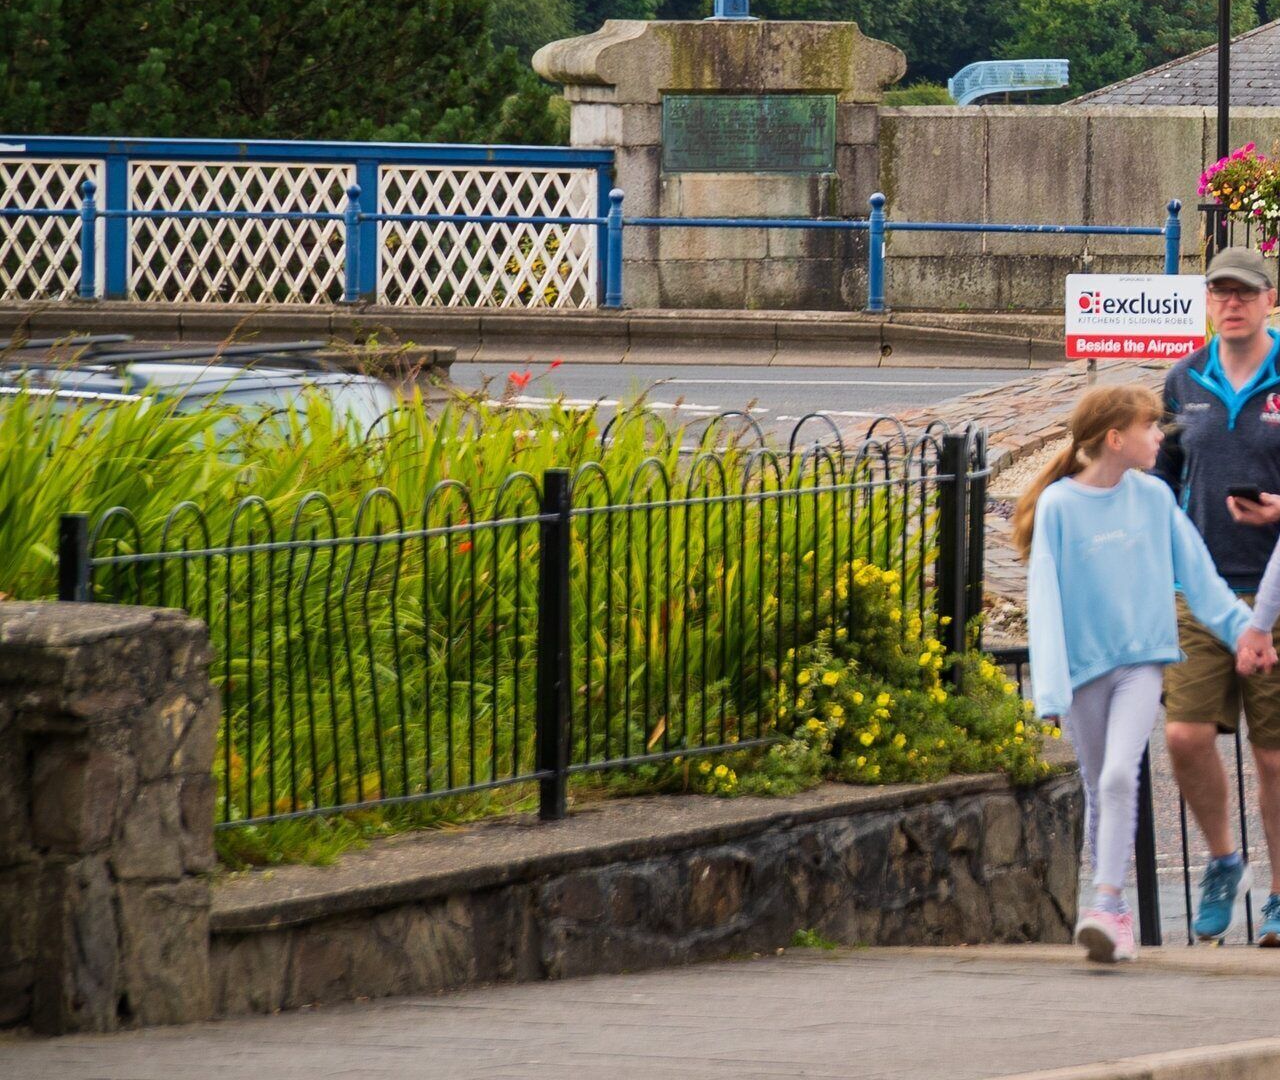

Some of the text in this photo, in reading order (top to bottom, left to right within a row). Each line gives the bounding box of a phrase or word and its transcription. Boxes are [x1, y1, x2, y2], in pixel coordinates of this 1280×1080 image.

[1103, 292, 1192, 314] exclusiv
[1078, 317, 1194, 325] KITCHENS SLIDING ROBES
[1076, 338, 1195, 356] Beside the Airport
